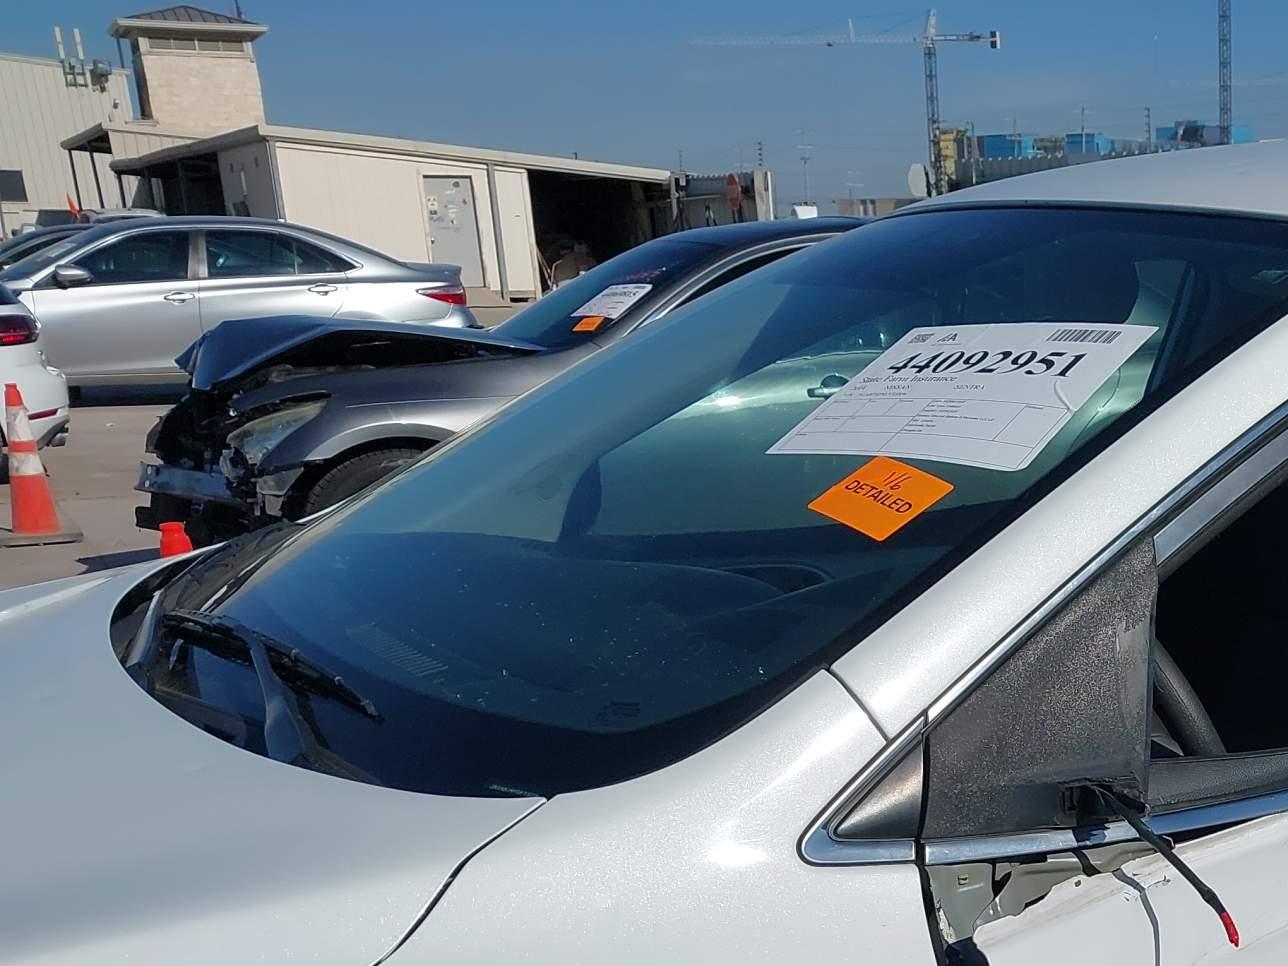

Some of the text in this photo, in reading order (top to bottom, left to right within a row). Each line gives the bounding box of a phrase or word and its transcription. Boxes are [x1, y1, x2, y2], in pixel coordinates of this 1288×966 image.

[887, 351, 1088, 378] 44092951
[862, 374, 958, 383] State Farm Insurance
[844, 479, 914, 514] DETAILED
